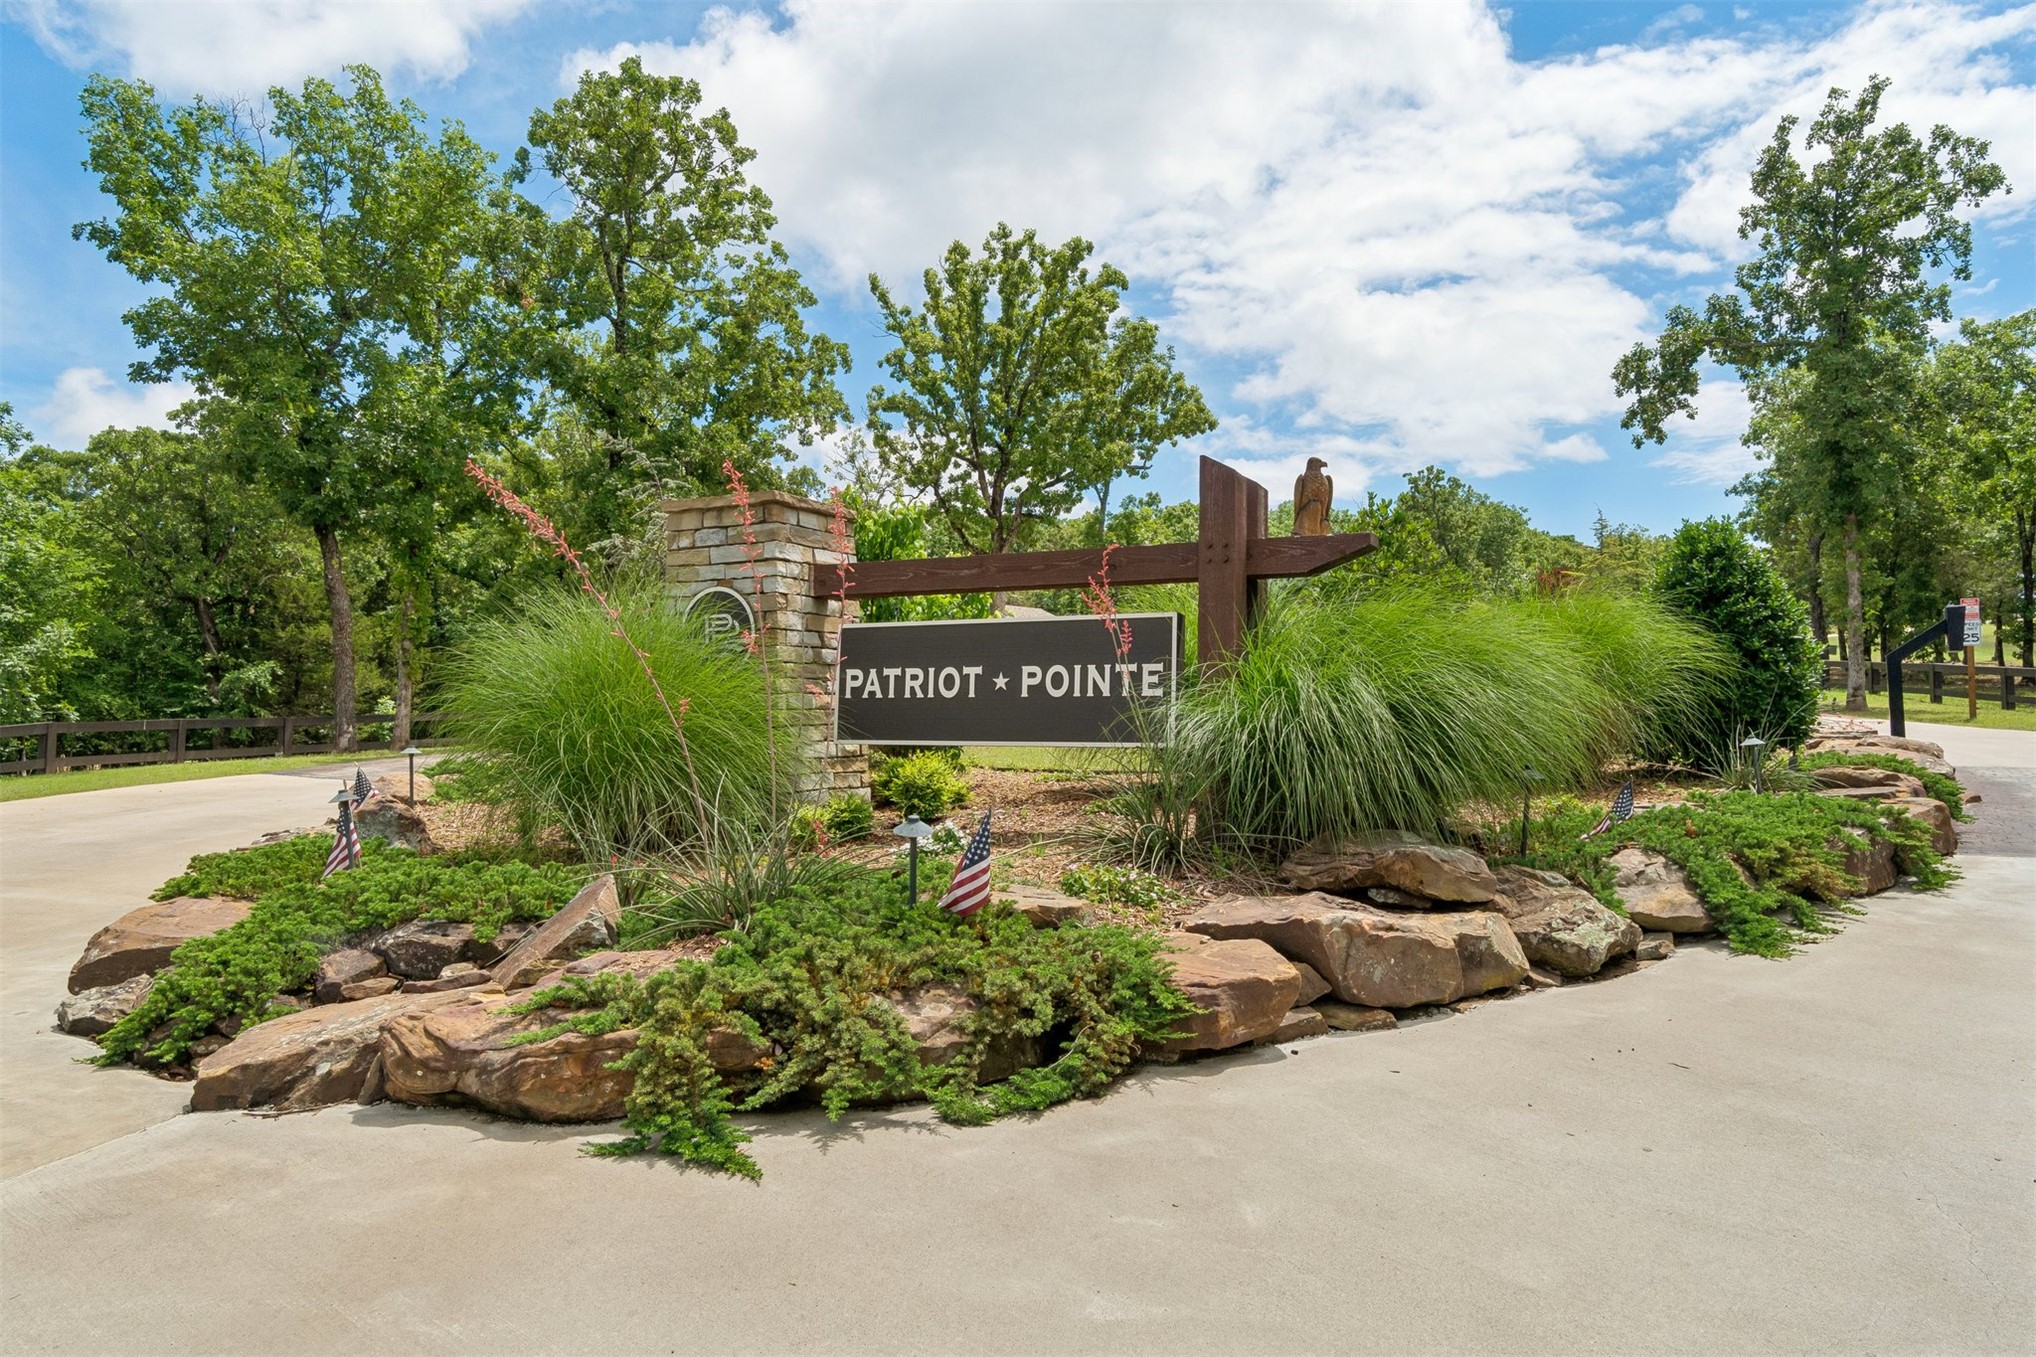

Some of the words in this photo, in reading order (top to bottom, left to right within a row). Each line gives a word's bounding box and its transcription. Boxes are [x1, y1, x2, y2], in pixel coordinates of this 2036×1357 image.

[1963, 633, 1980, 643] 25
[844, 665, 983, 699] PATRIOT
[1020, 662, 1164, 698] POINTE
